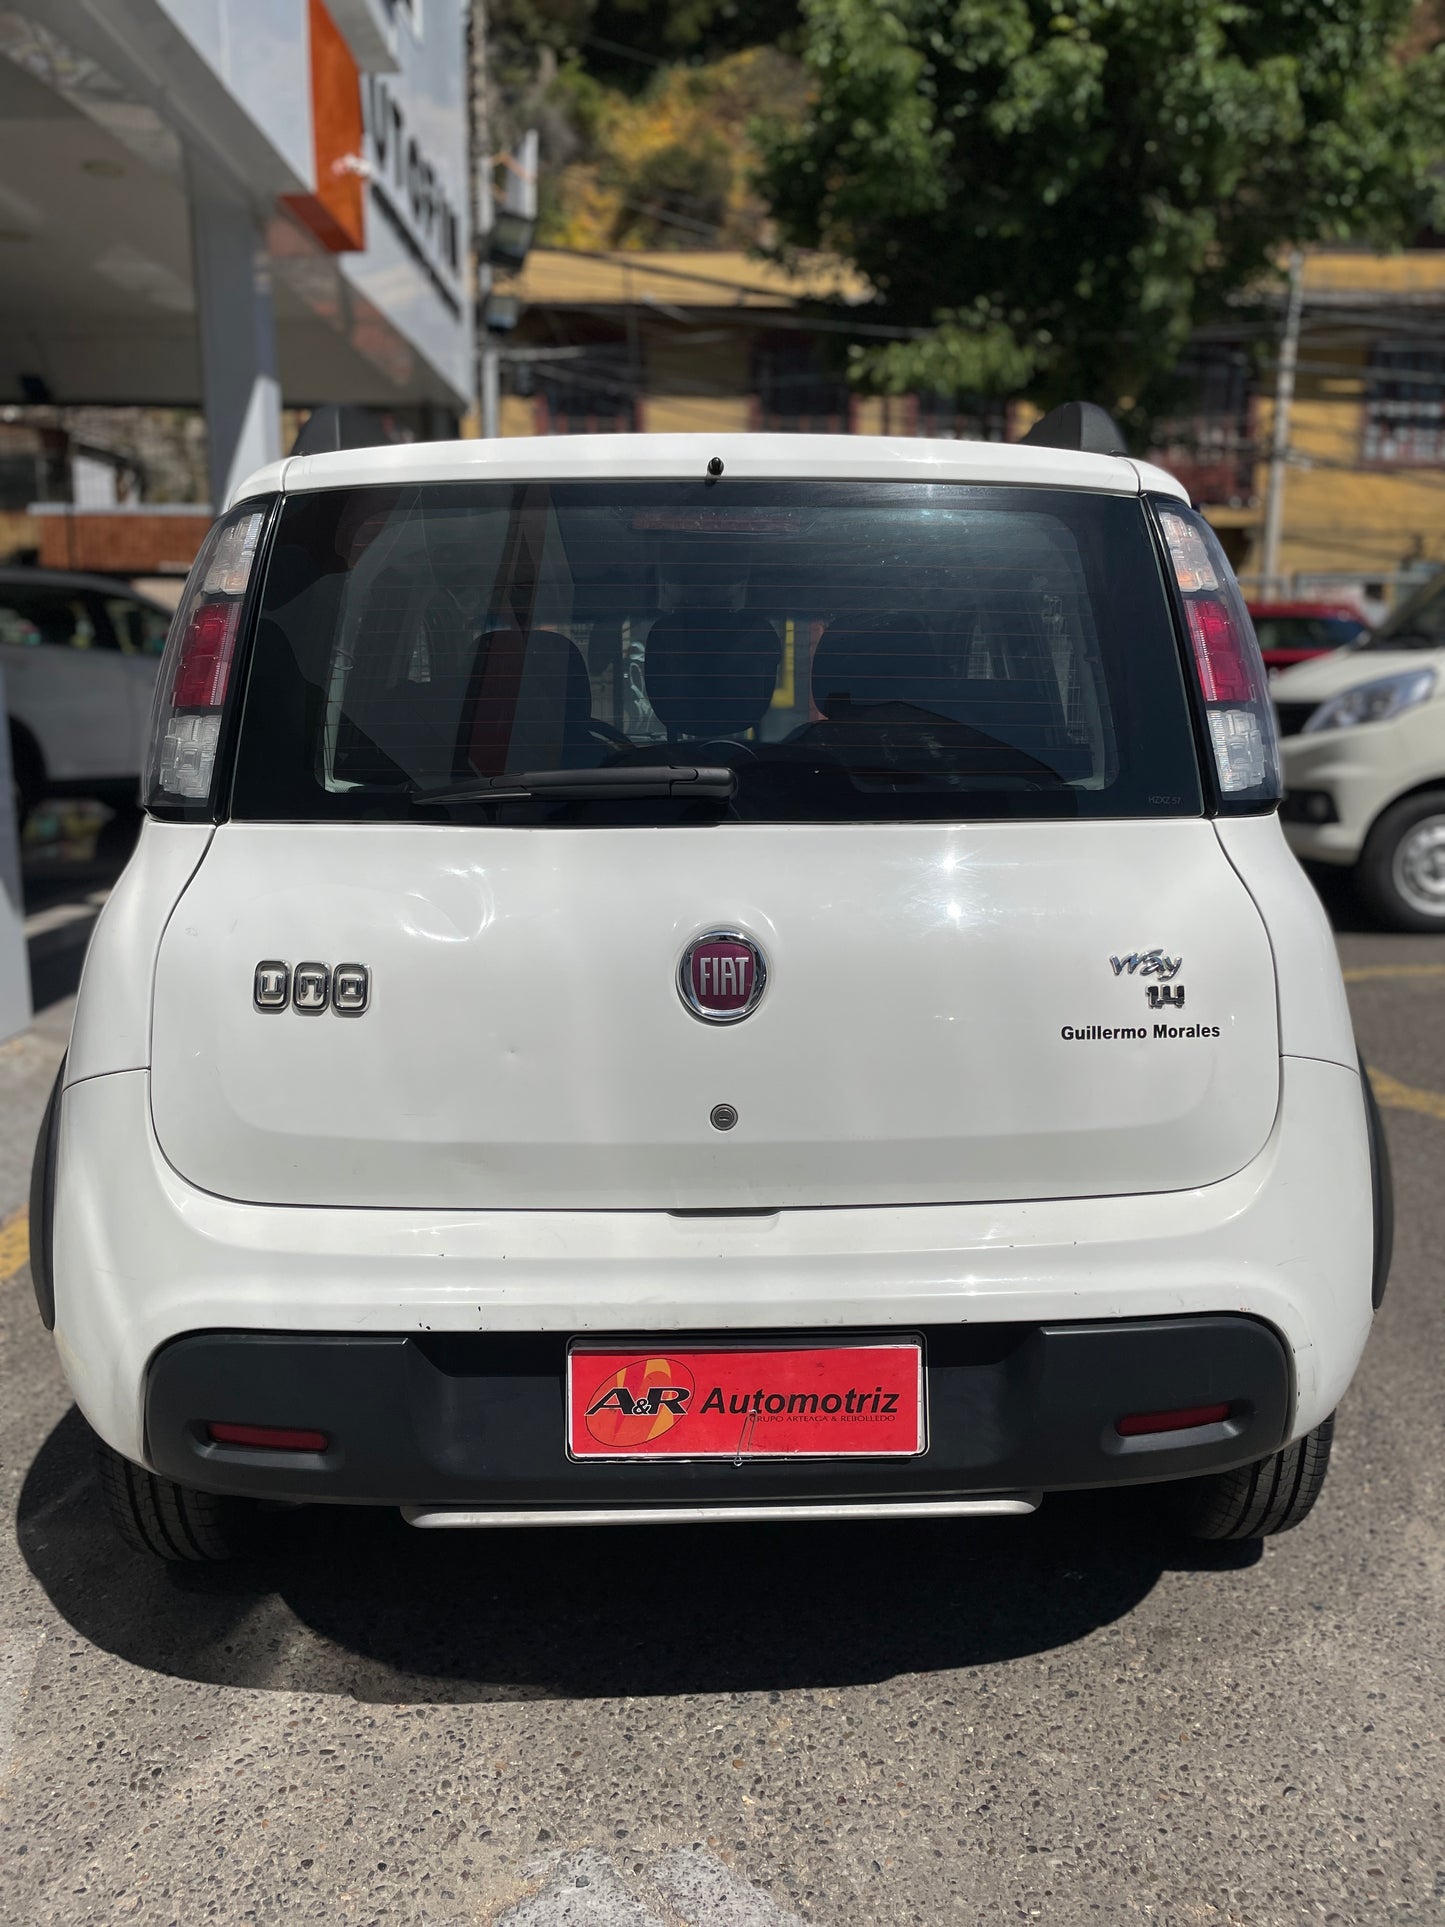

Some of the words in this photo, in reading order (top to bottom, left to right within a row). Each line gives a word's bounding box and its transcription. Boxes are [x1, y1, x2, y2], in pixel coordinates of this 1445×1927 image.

[700, 957, 749, 996] FIAT
[1061, 1025, 1147, 1040] Guillermo
[1153, 1024, 1220, 1039] Morales
[584, 1386, 689, 1416] A&R
[700, 1386, 900, 1415] Automotriz
[840, 1414, 896, 1422] REBOLLEDO
